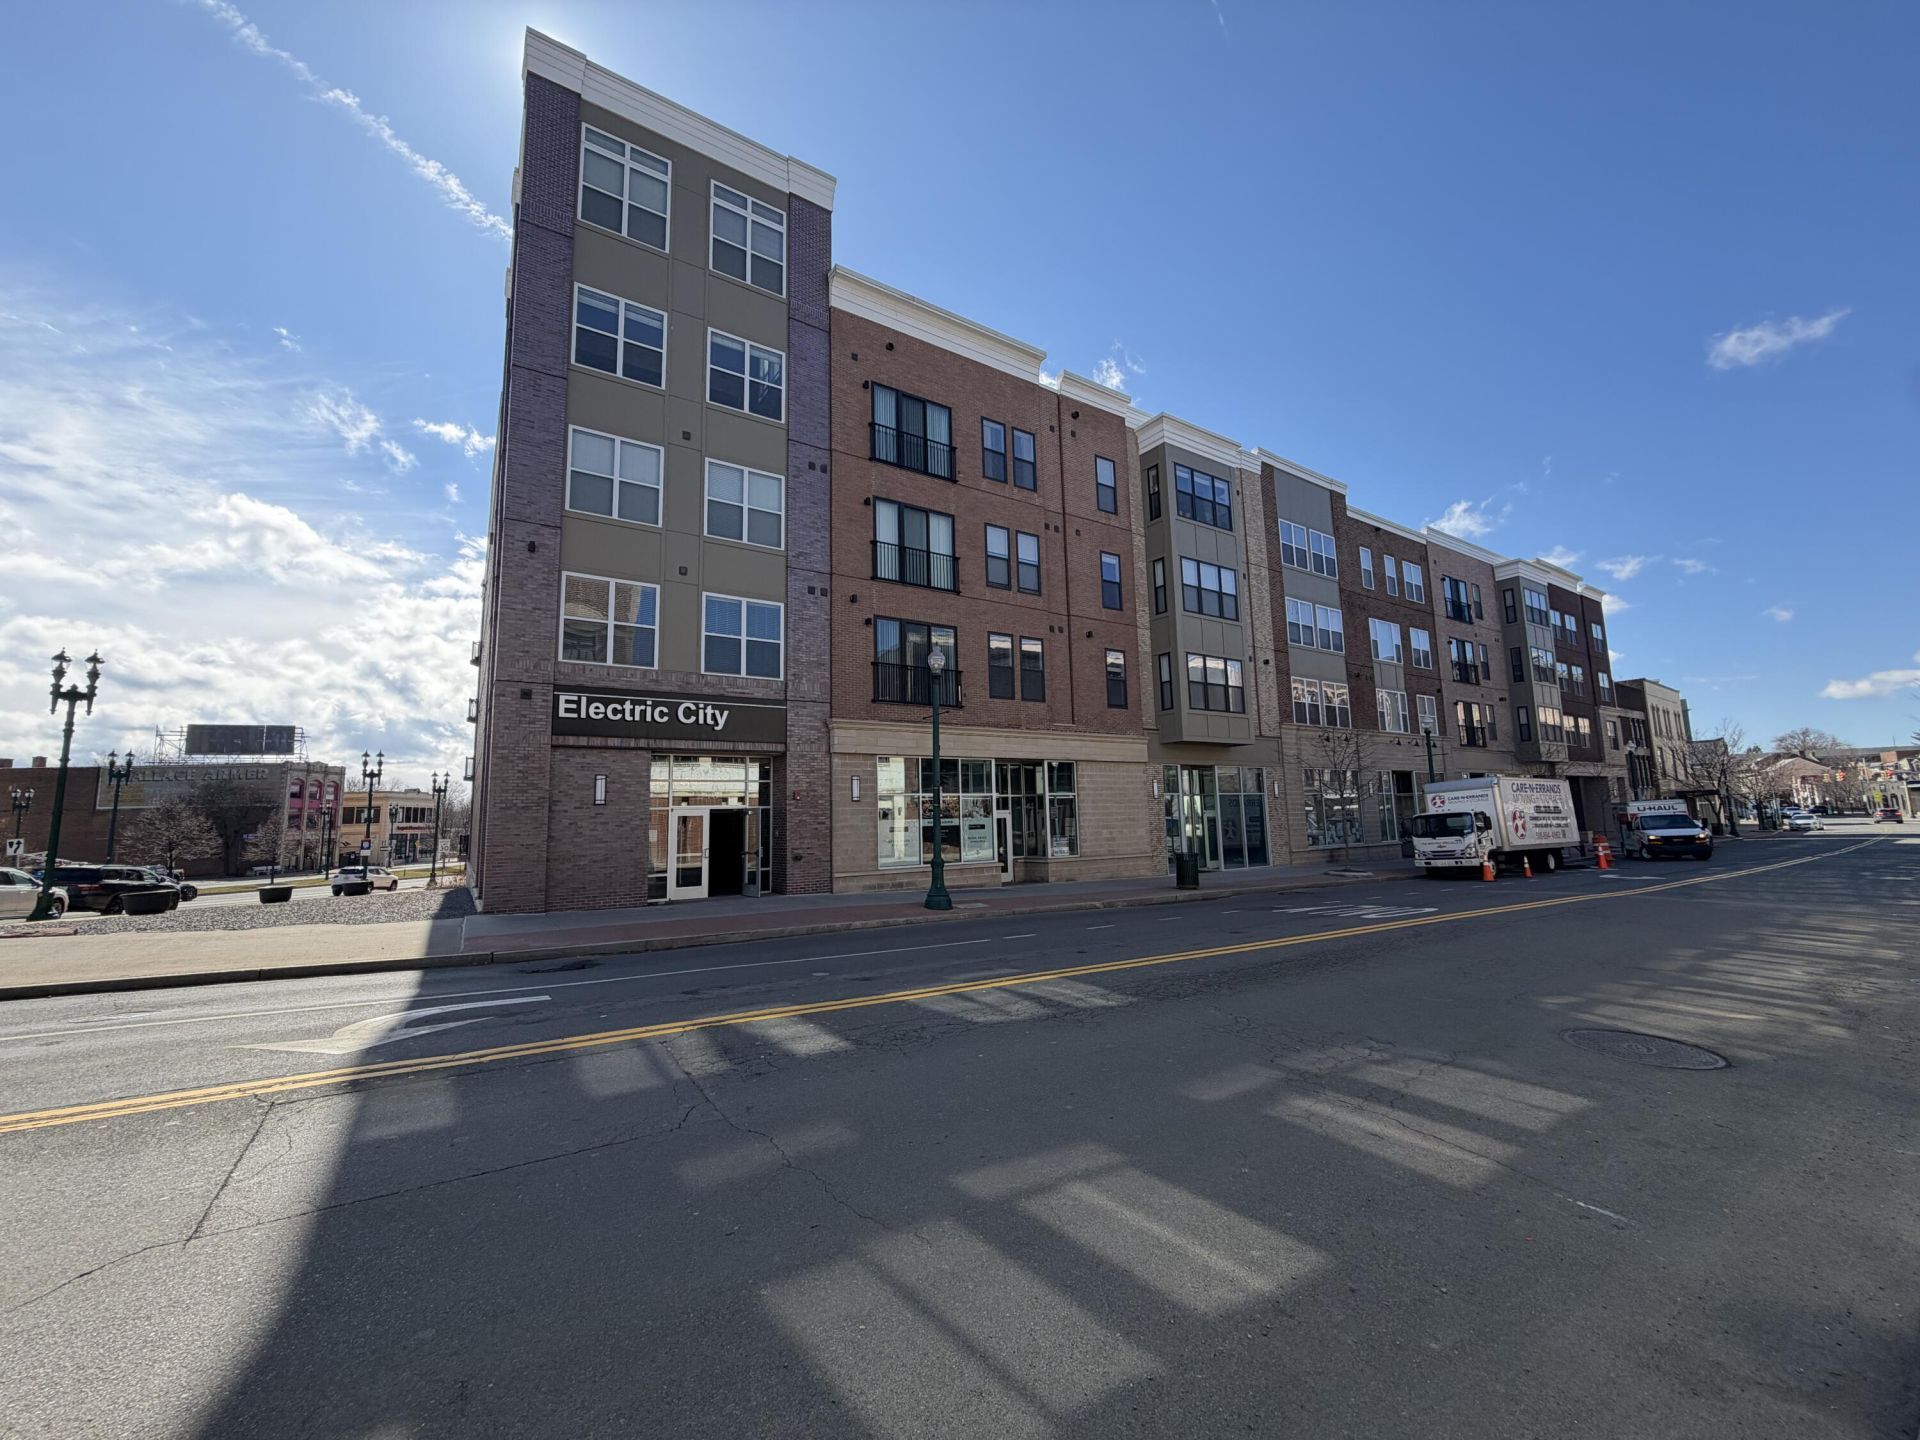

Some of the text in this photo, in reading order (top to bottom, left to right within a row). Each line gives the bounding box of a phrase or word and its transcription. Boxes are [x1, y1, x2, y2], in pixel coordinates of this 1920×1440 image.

[557, 694, 729, 731] Electric City
[124, 769, 196, 782] ALLACE
